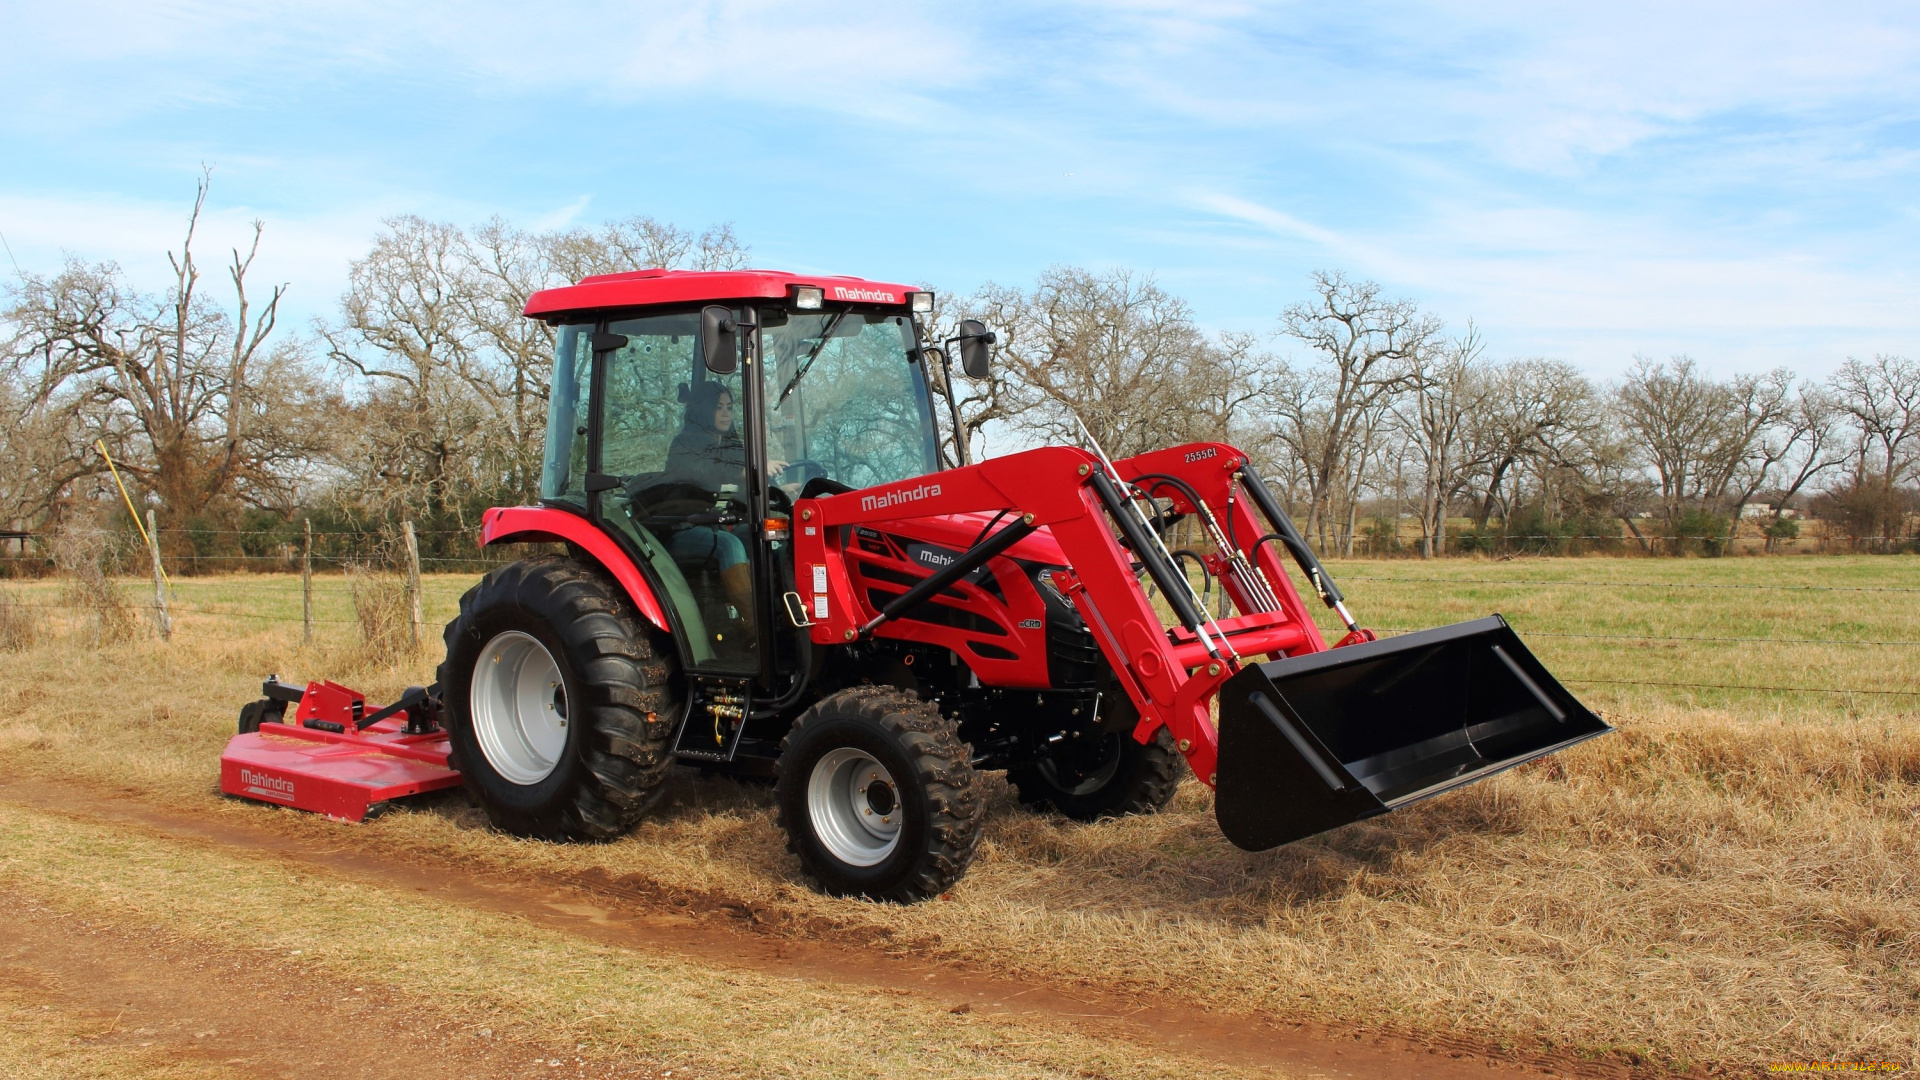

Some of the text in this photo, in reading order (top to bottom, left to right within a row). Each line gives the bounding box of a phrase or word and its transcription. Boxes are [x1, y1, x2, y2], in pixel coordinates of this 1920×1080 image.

[834, 286, 895, 302] Mahindra
[1184, 447, 1218, 464] 2555CL
[861, 484, 942, 512] Mahindra
[241, 768, 295, 793] Mahindra
